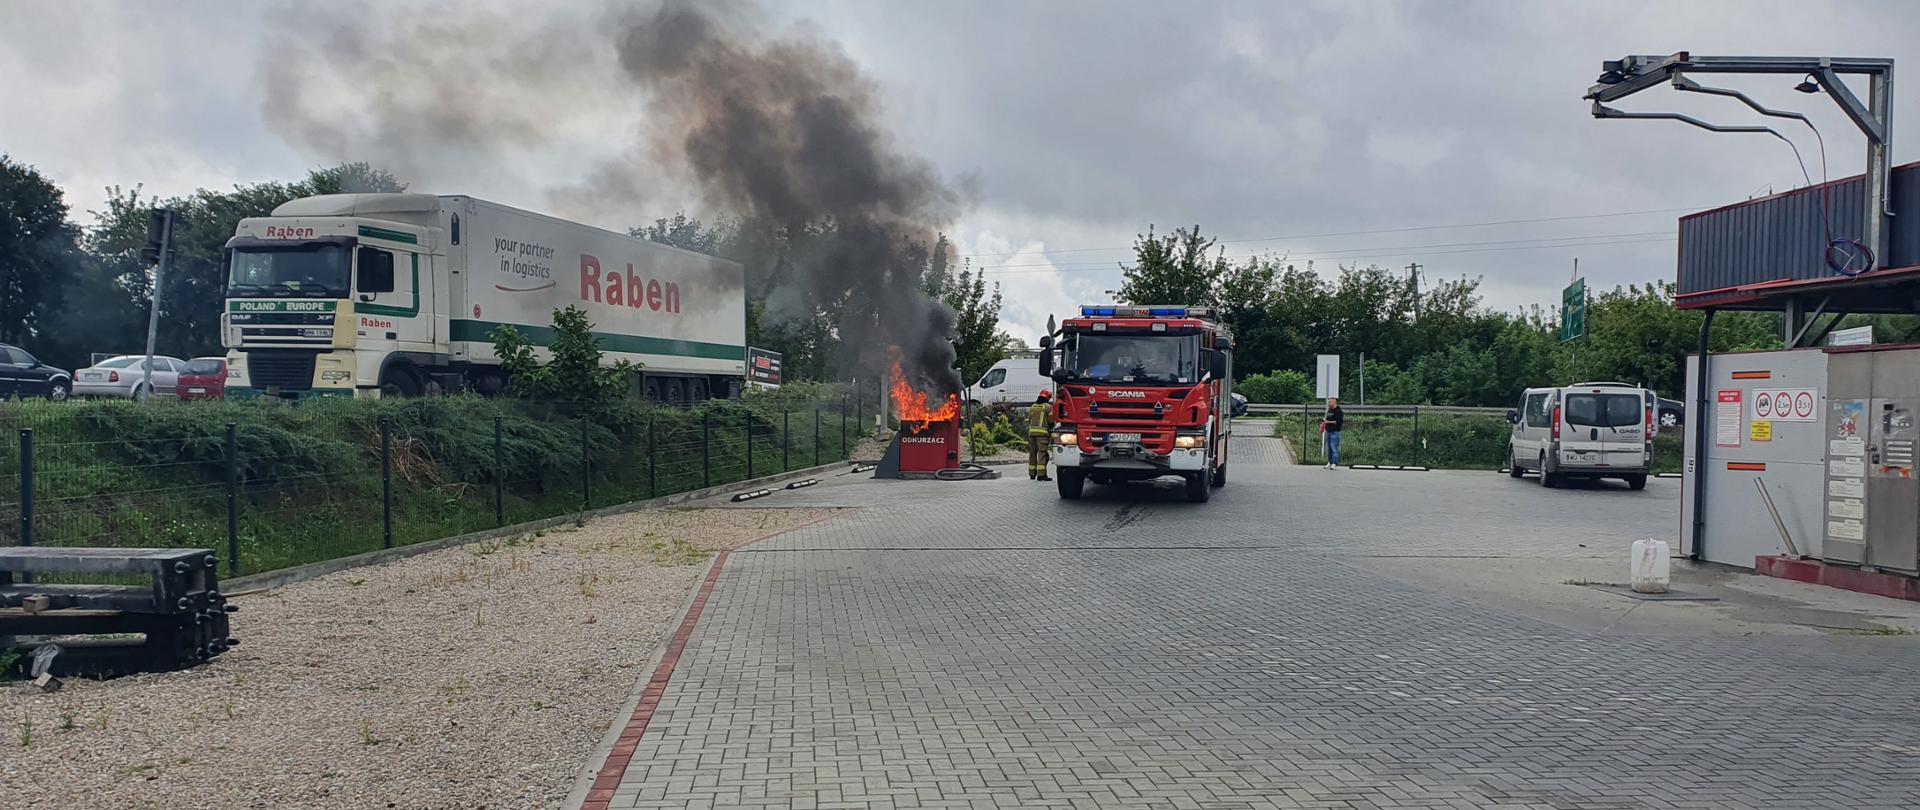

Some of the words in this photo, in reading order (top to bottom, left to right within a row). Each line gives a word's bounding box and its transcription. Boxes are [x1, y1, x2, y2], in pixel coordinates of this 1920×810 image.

[266, 226, 314, 238] Raben
[494, 237, 518, 254] your
[519, 242, 555, 260] partner
[500, 255, 510, 272] in
[512, 257, 551, 279] logistics
[580, 253, 681, 314] Raben
[240, 302, 276, 311] POLAND
[286, 302, 325, 311] EUROPE
[361, 317, 392, 329] Raben
[1107, 390, 1146, 398] SCANIA
